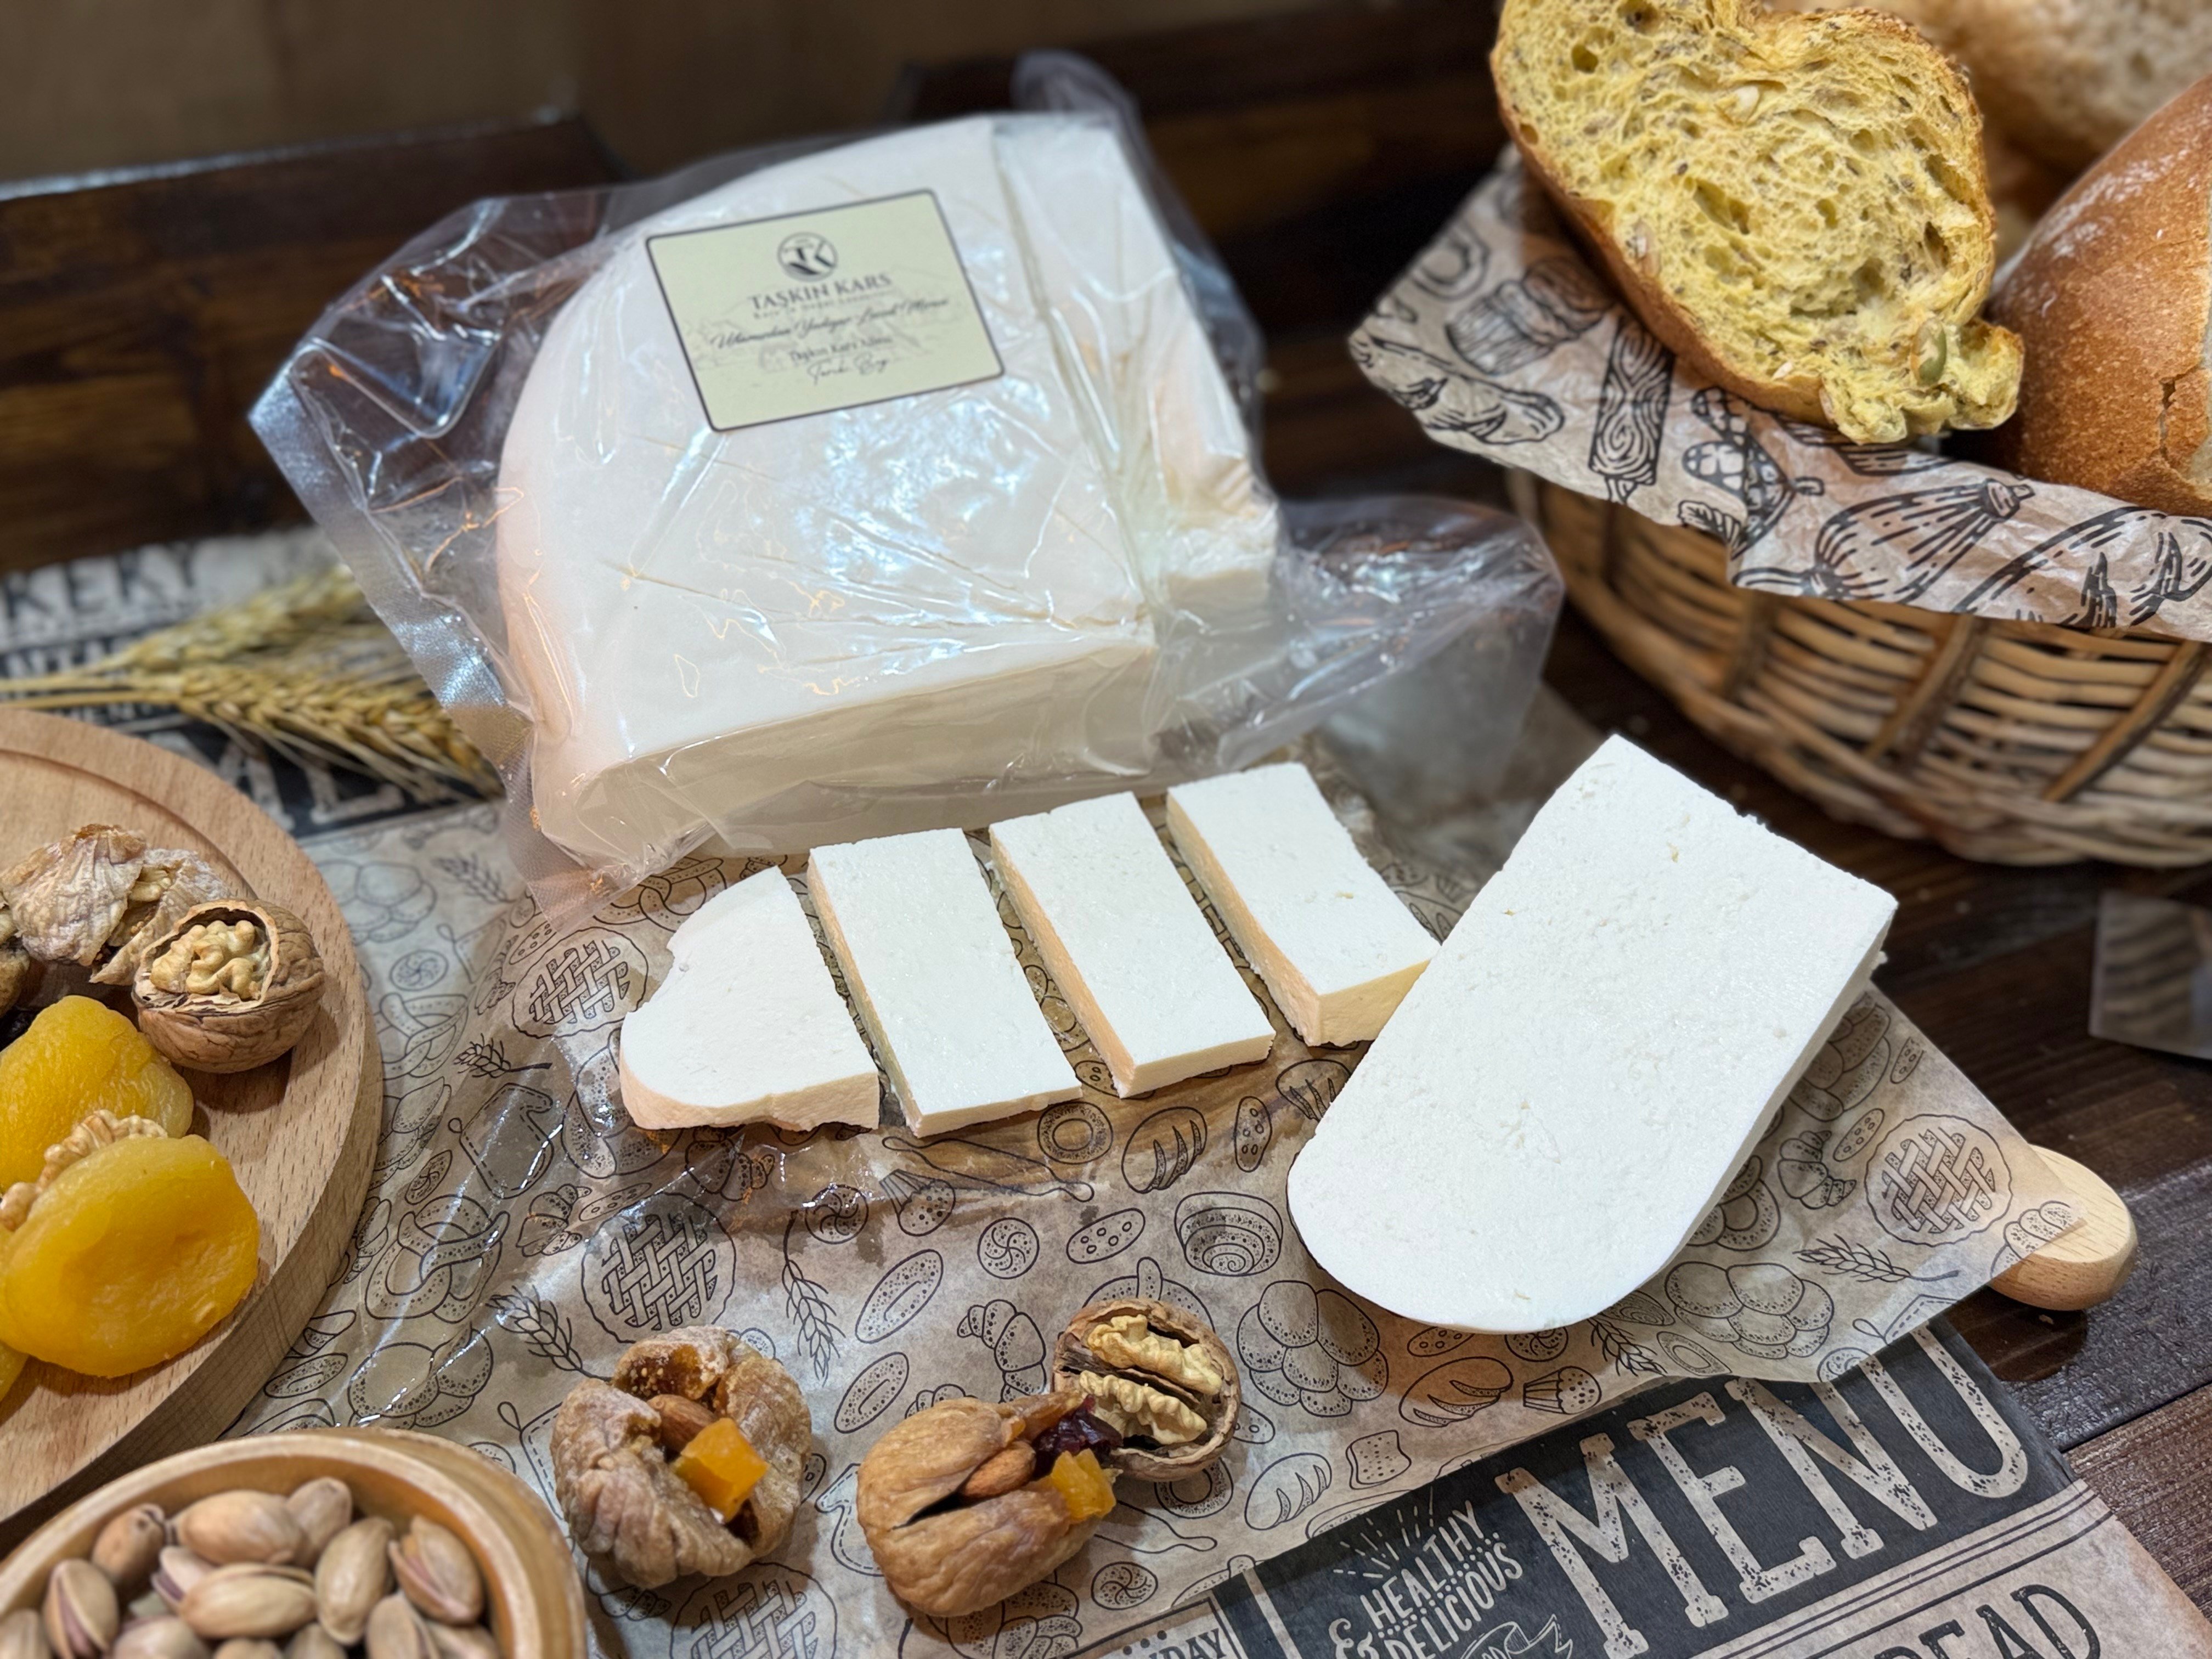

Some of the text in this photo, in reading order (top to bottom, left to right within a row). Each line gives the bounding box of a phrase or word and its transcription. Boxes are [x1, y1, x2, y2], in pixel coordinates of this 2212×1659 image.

[834, 274, 893, 295] KARS
[1494, 1319, 2030, 1658] MENU
[1359, 1499, 1485, 1629] HEALTHY
[1383, 1542, 1523, 1659] DELICIOUS
[1148, 1628, 1227, 1659] DAY
[1874, 1584, 2101, 1659] EAD
